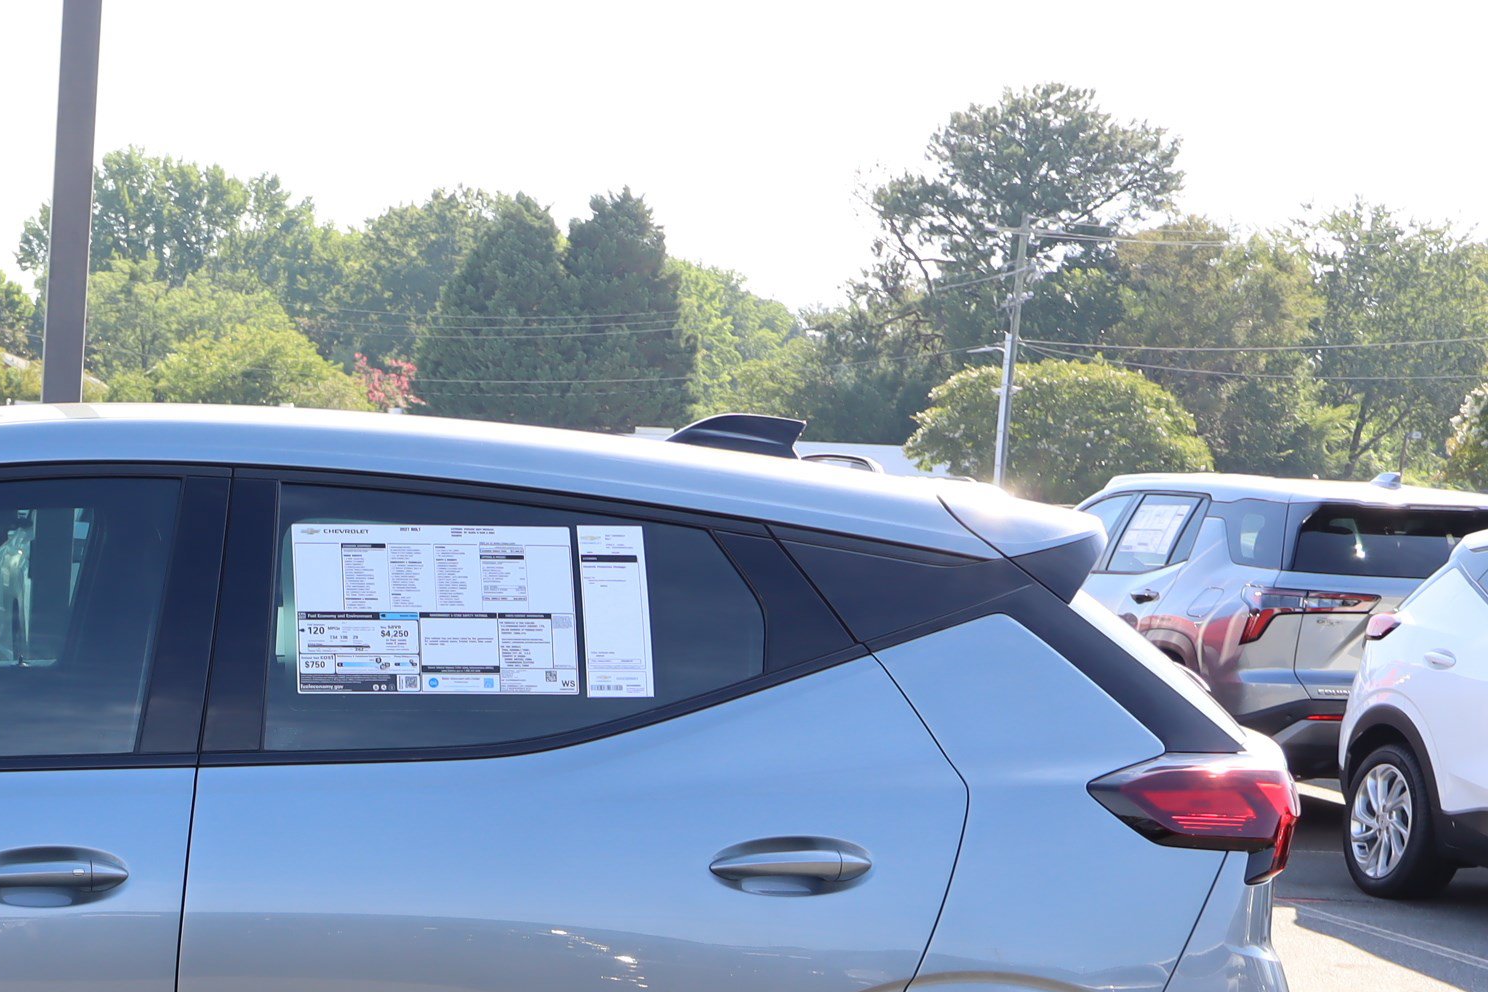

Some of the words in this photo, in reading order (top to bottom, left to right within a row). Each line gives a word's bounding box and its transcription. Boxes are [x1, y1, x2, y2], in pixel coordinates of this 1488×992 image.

[307, 626, 325, 635] 120
[380, 629, 409, 638] $4,250
[304, 660, 326, 669] $750
[561, 680, 576, 688] WS
